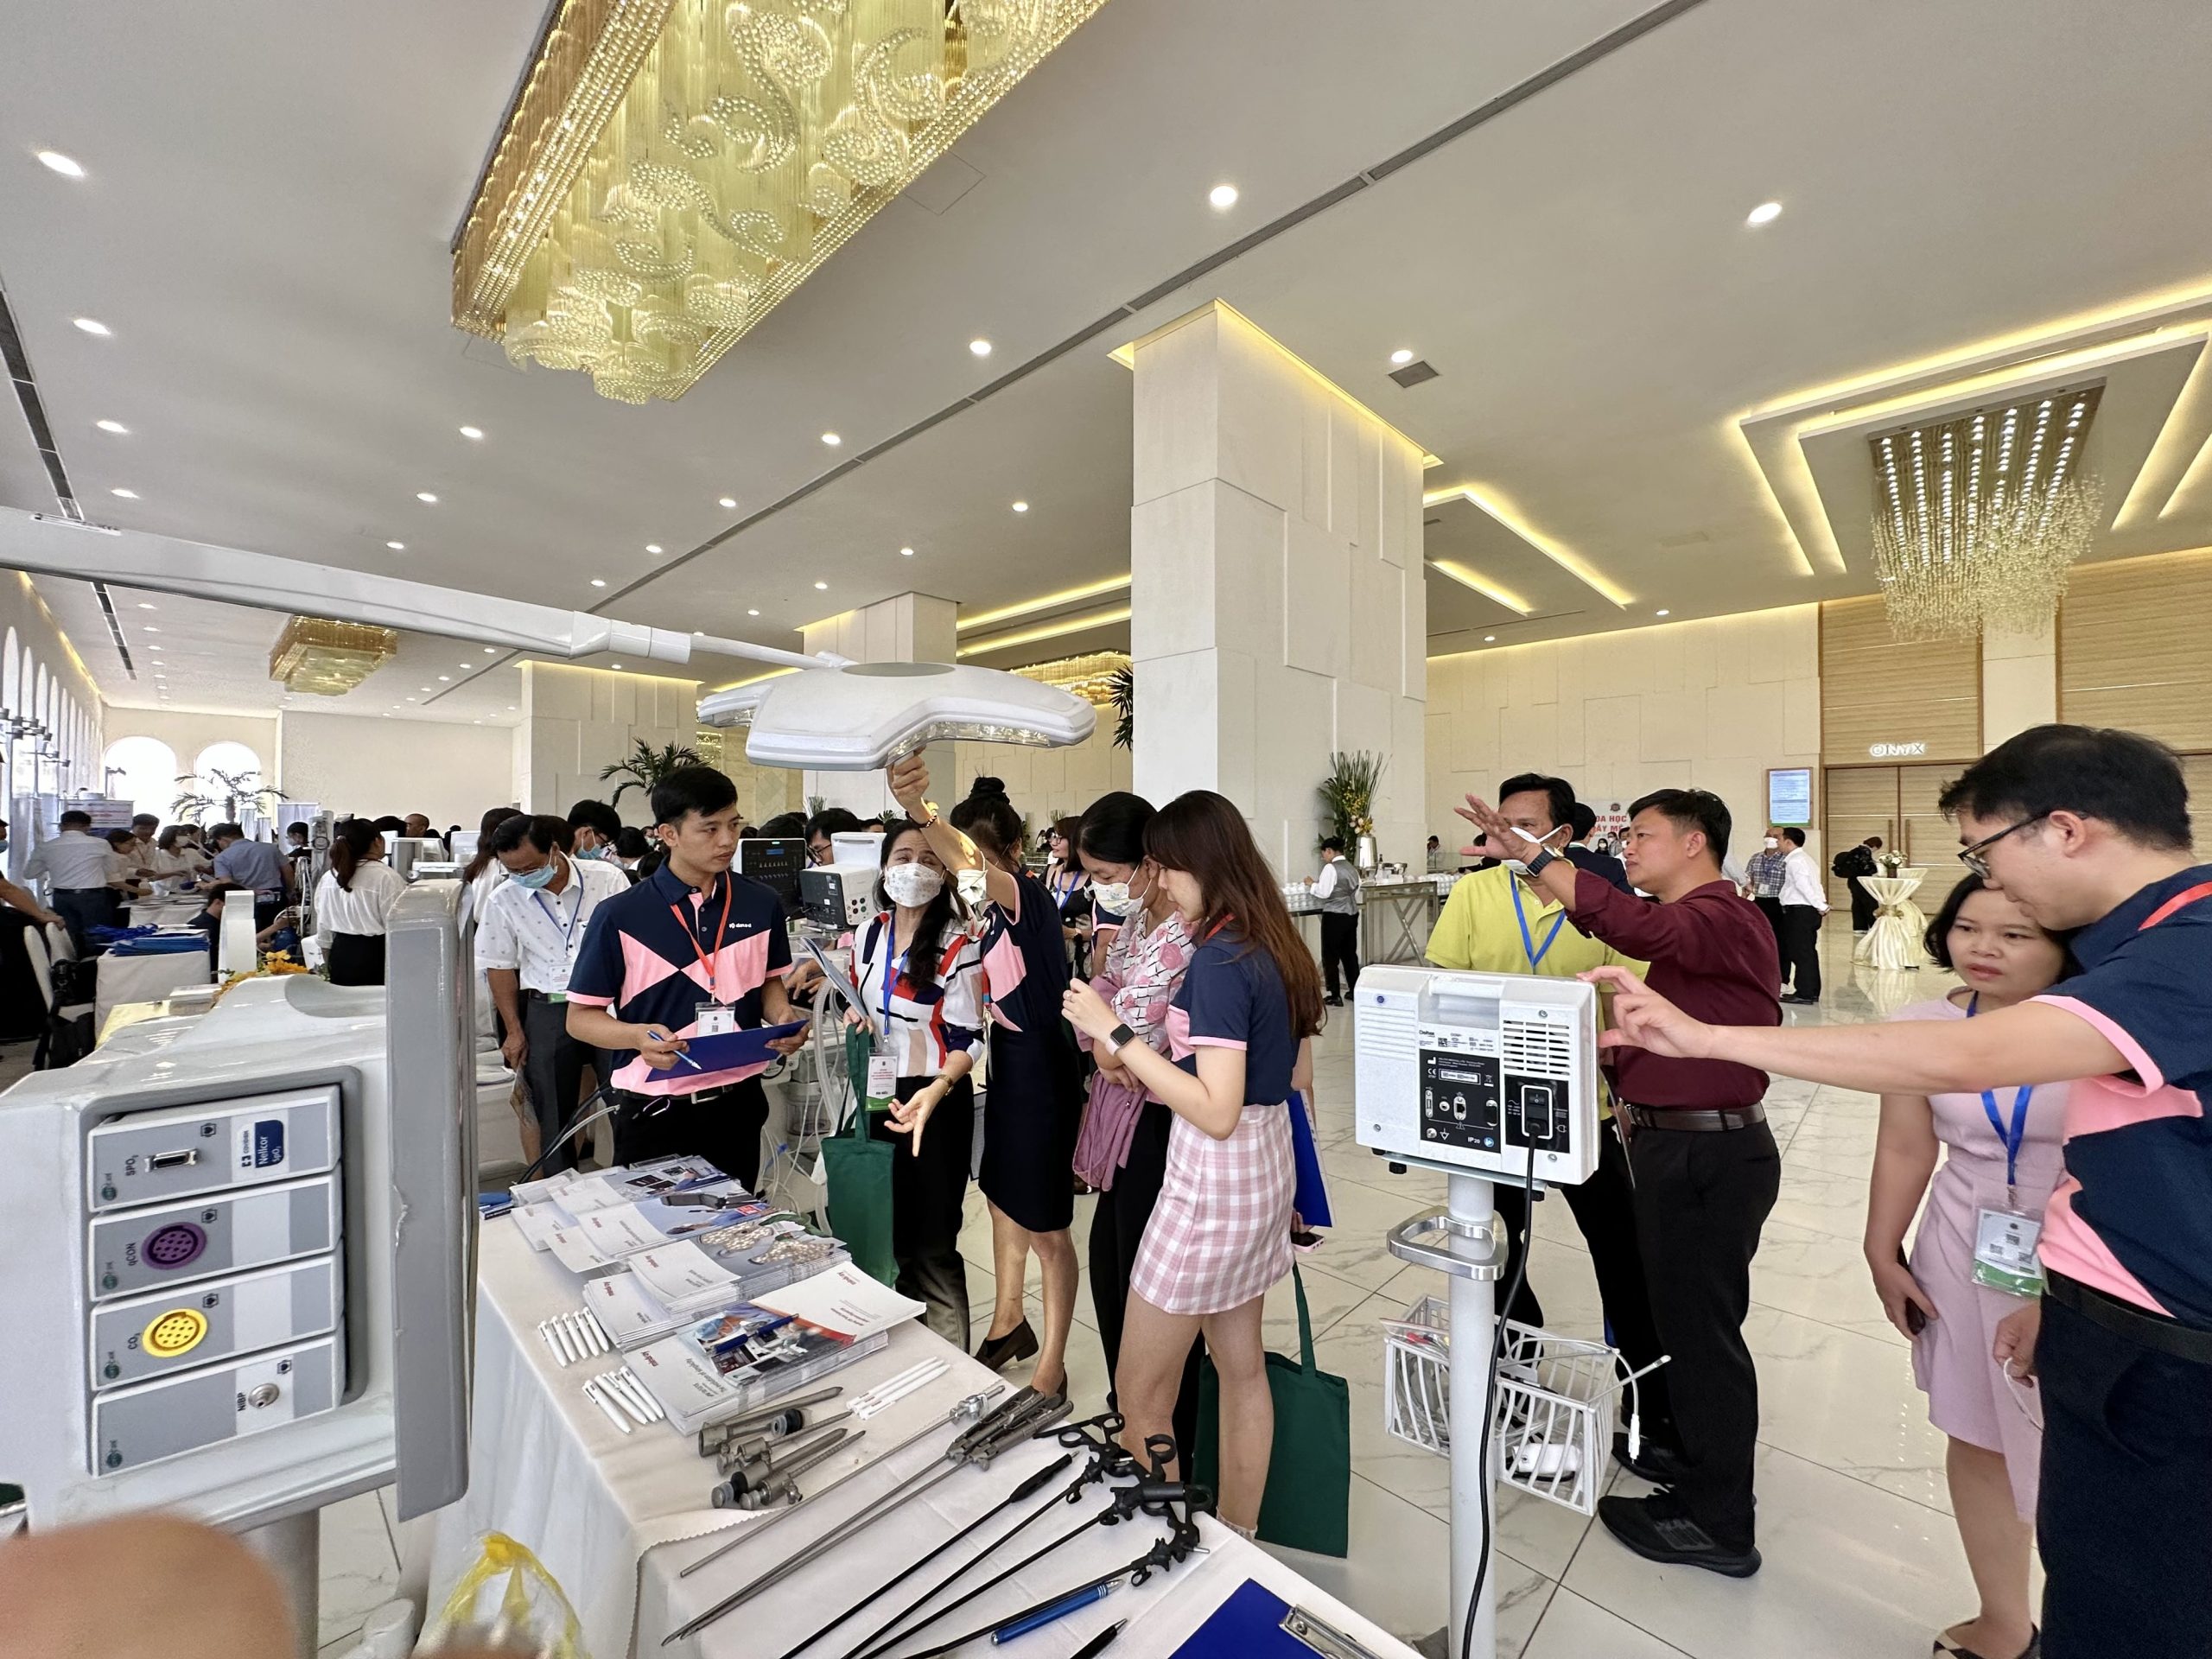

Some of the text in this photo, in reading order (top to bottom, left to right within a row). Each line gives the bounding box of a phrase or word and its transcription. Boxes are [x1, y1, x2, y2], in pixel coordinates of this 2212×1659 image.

[1870, 742, 1925, 757] ONYX
[257, 1136, 268, 1165] Nellcor
[125, 1242, 138, 1267] qCON
[237, 1392, 246, 1412] NIBP
